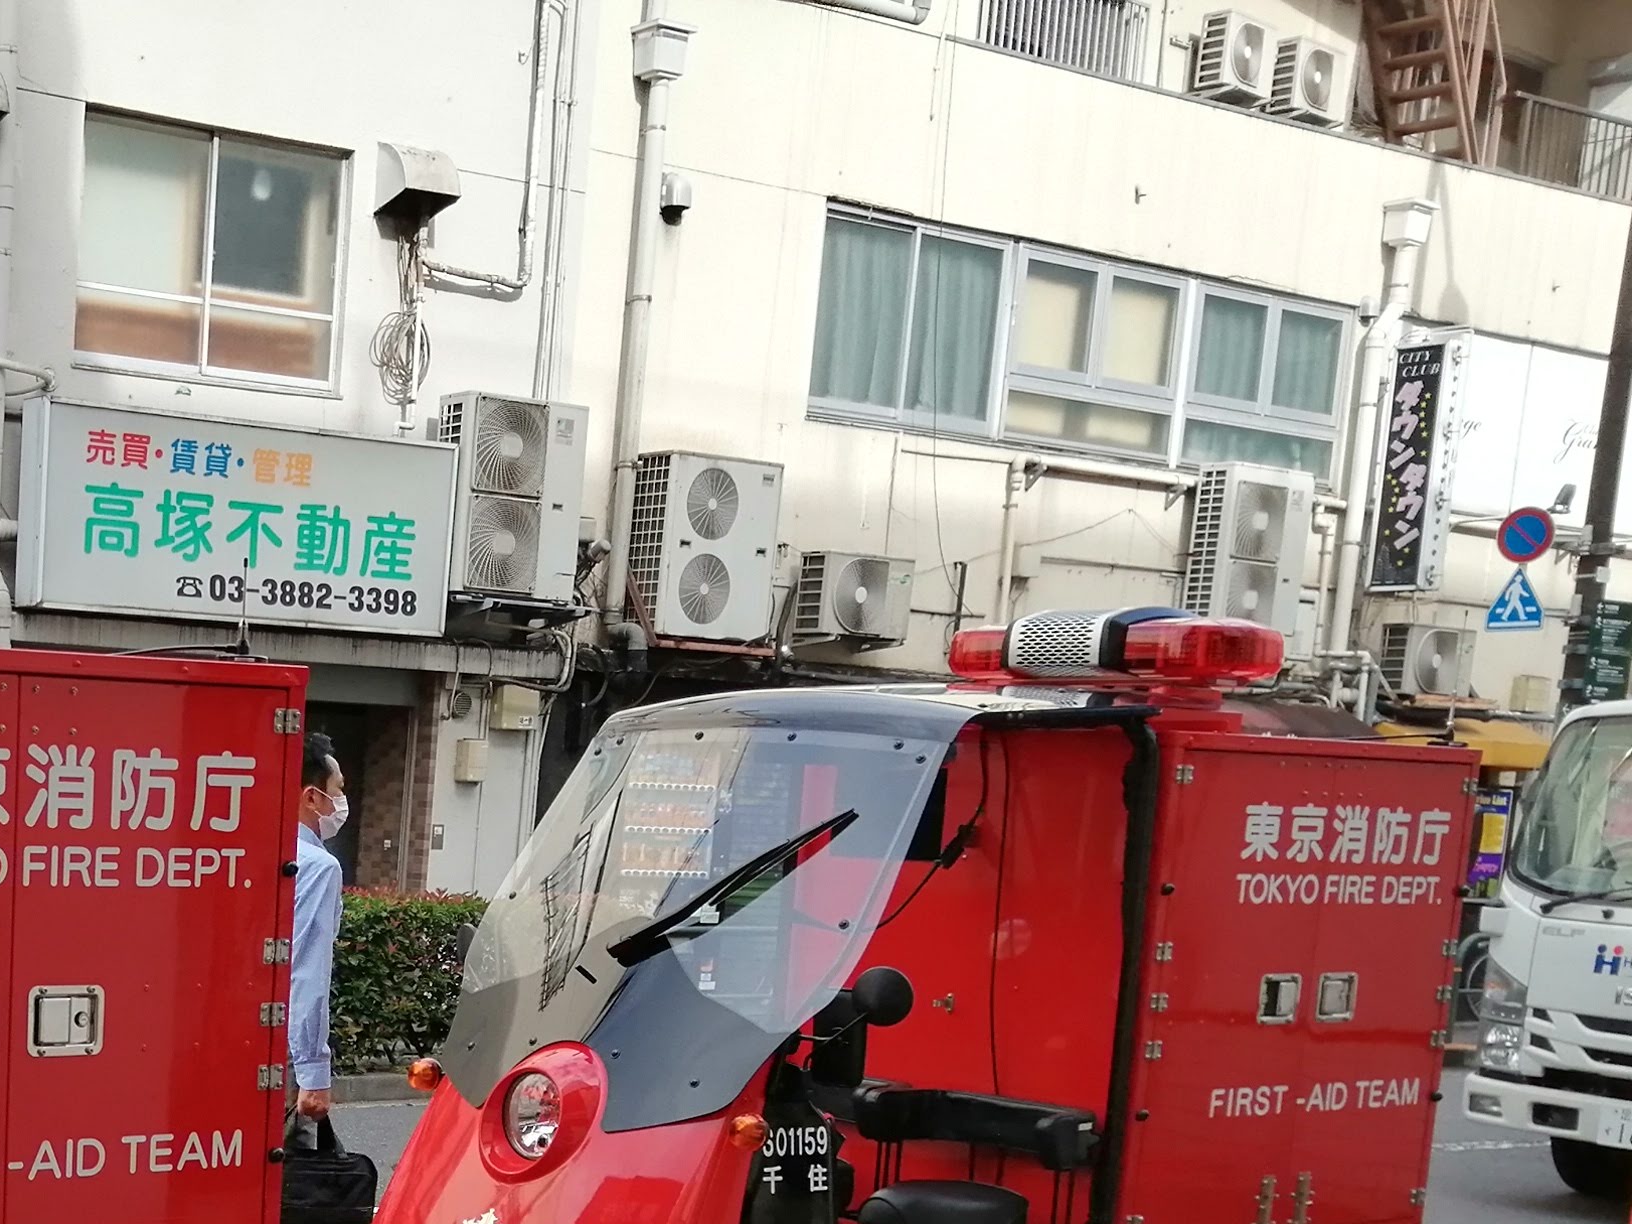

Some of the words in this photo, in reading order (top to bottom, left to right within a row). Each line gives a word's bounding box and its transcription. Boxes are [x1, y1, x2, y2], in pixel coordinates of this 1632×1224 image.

[1398, 350, 1433, 365] CITY
[1401, 362, 1441, 378] CLUB
[85, 429, 313, 487] 売買・賃貸・管理
[1389, 380, 1427, 550] ダウンタウン
[84, 482, 416, 581] 高塚不動産
[209, 574, 418, 617] 03-3882-3398
[1240, 801, 1452, 866] 東京消防庁
[22, 845, 121, 888] FIRE
[135, 847, 253, 889] DEPT.
[1236, 873, 1320, 905] TOKYO
[1324, 874, 1377, 905] FIRE
[1381, 876, 1443, 906] DEPT.
[1209, 1085, 1289, 1118] FIRST
[1356, 1078, 1420, 1109] TEAM
[122, 1129, 243, 1174] TEAM
